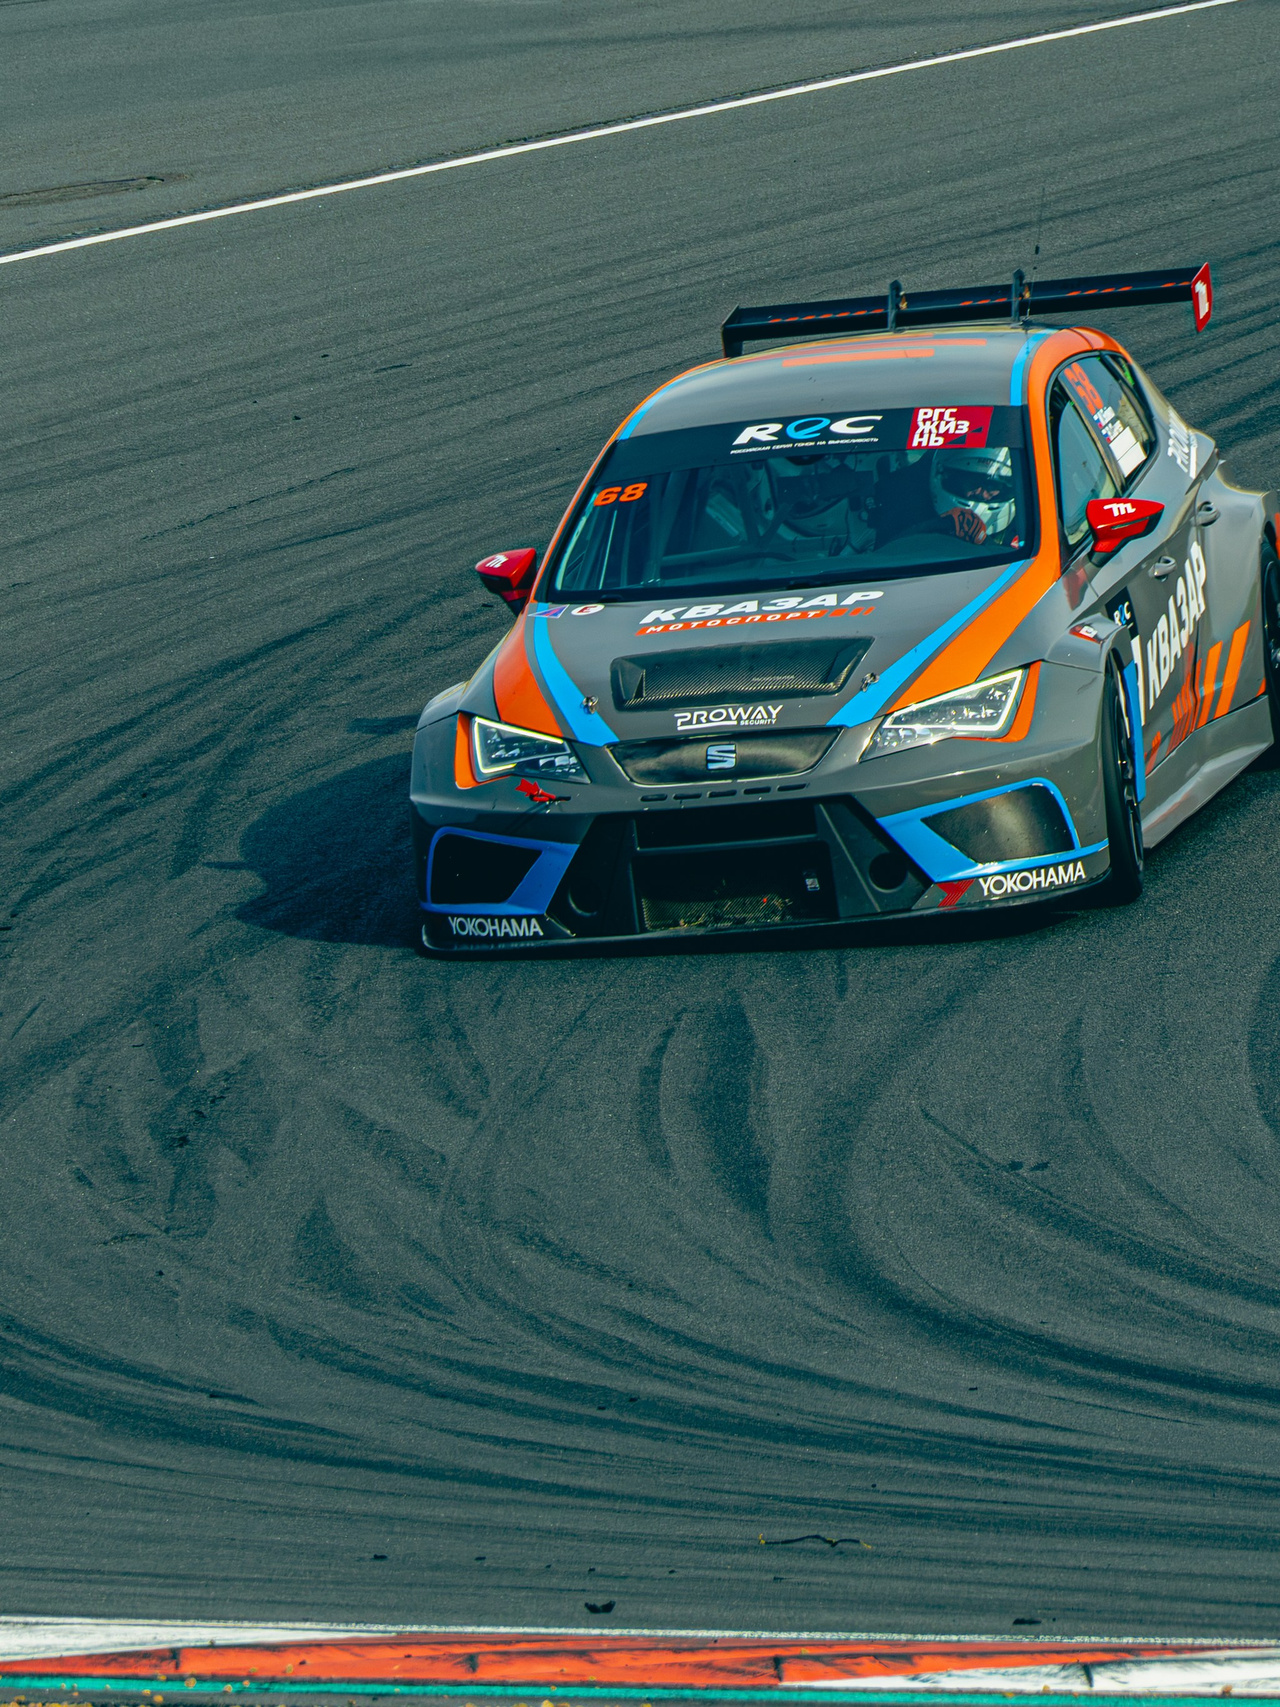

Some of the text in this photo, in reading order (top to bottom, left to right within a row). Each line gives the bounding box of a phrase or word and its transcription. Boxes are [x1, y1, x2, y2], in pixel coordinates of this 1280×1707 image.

[917, 408, 957, 423] РГС
[916, 420, 970, 435] ЖИЗ
[911, 433, 944, 447] НЬ
[593, 482, 648, 506] 68
[639, 591, 884, 624] КВАЗАР
[646, 610, 821, 633] МОТОСПОРТ
[1147, 541, 1206, 710] КВАЗАР
[674, 705, 783, 727] PROWAY
[740, 718, 778, 726] SECURITY
[979, 861, 1086, 897] YOKOHAMA
[448, 916, 544, 937] YOKOHAMA
